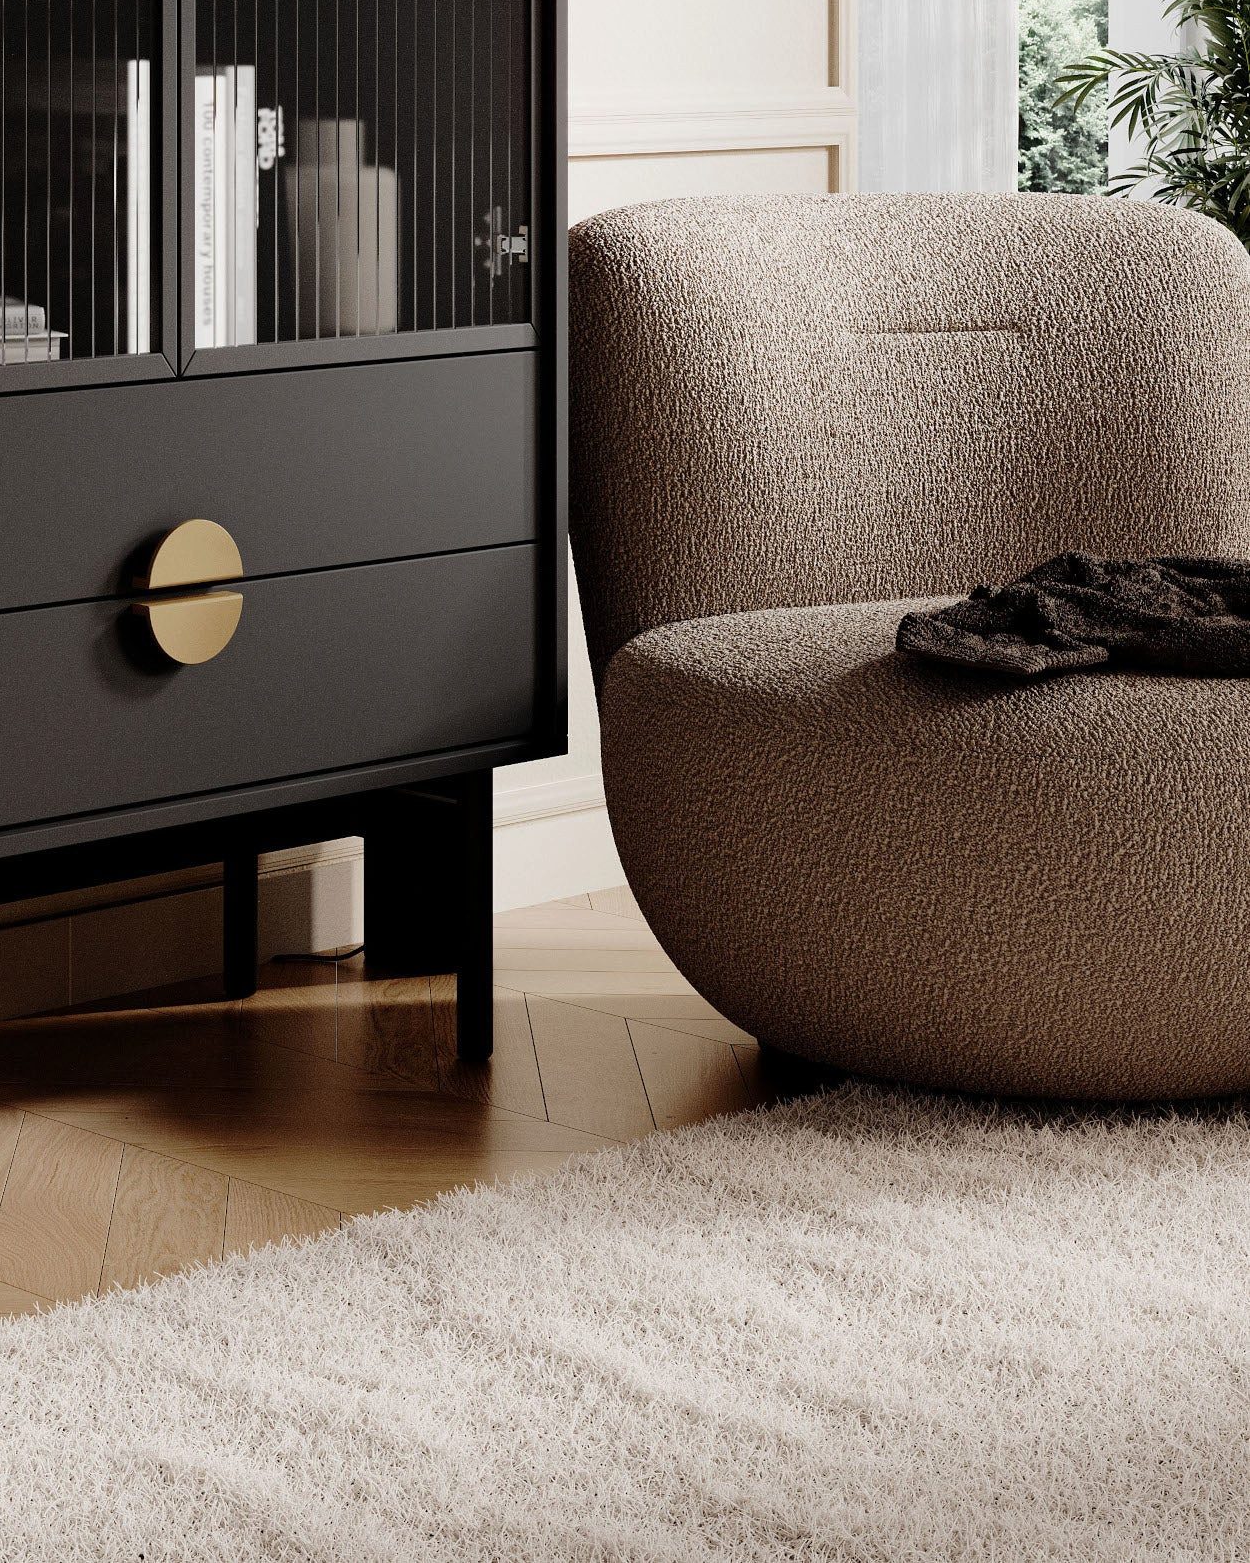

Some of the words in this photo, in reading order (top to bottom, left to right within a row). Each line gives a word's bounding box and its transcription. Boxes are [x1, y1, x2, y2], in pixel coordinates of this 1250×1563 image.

[202, 102, 214, 130] 100
[200, 137, 214, 258] contemporary
[202, 265, 214, 326] houses
